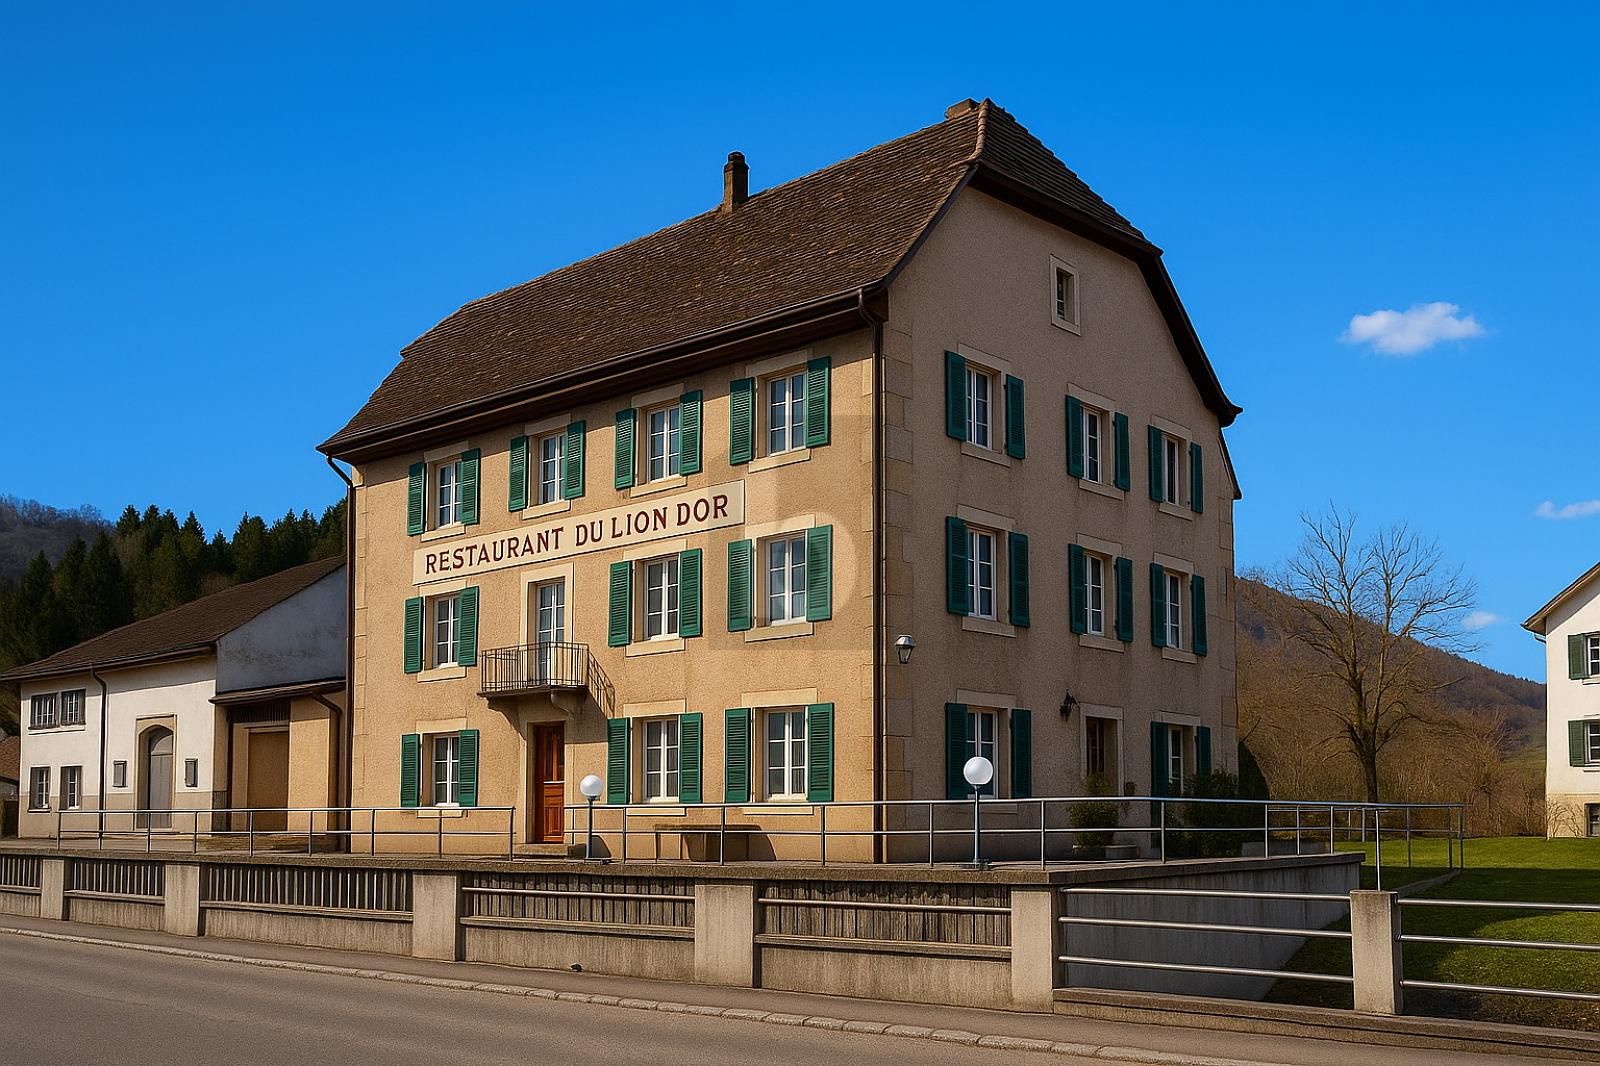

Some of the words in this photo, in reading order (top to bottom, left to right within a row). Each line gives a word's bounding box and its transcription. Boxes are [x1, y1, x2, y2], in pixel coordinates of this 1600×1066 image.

[425, 526, 564, 575] RESTAURANT
[575, 519, 603, 547] DU
[611, 506, 668, 539] LION
[676, 494, 728, 527] DOR
